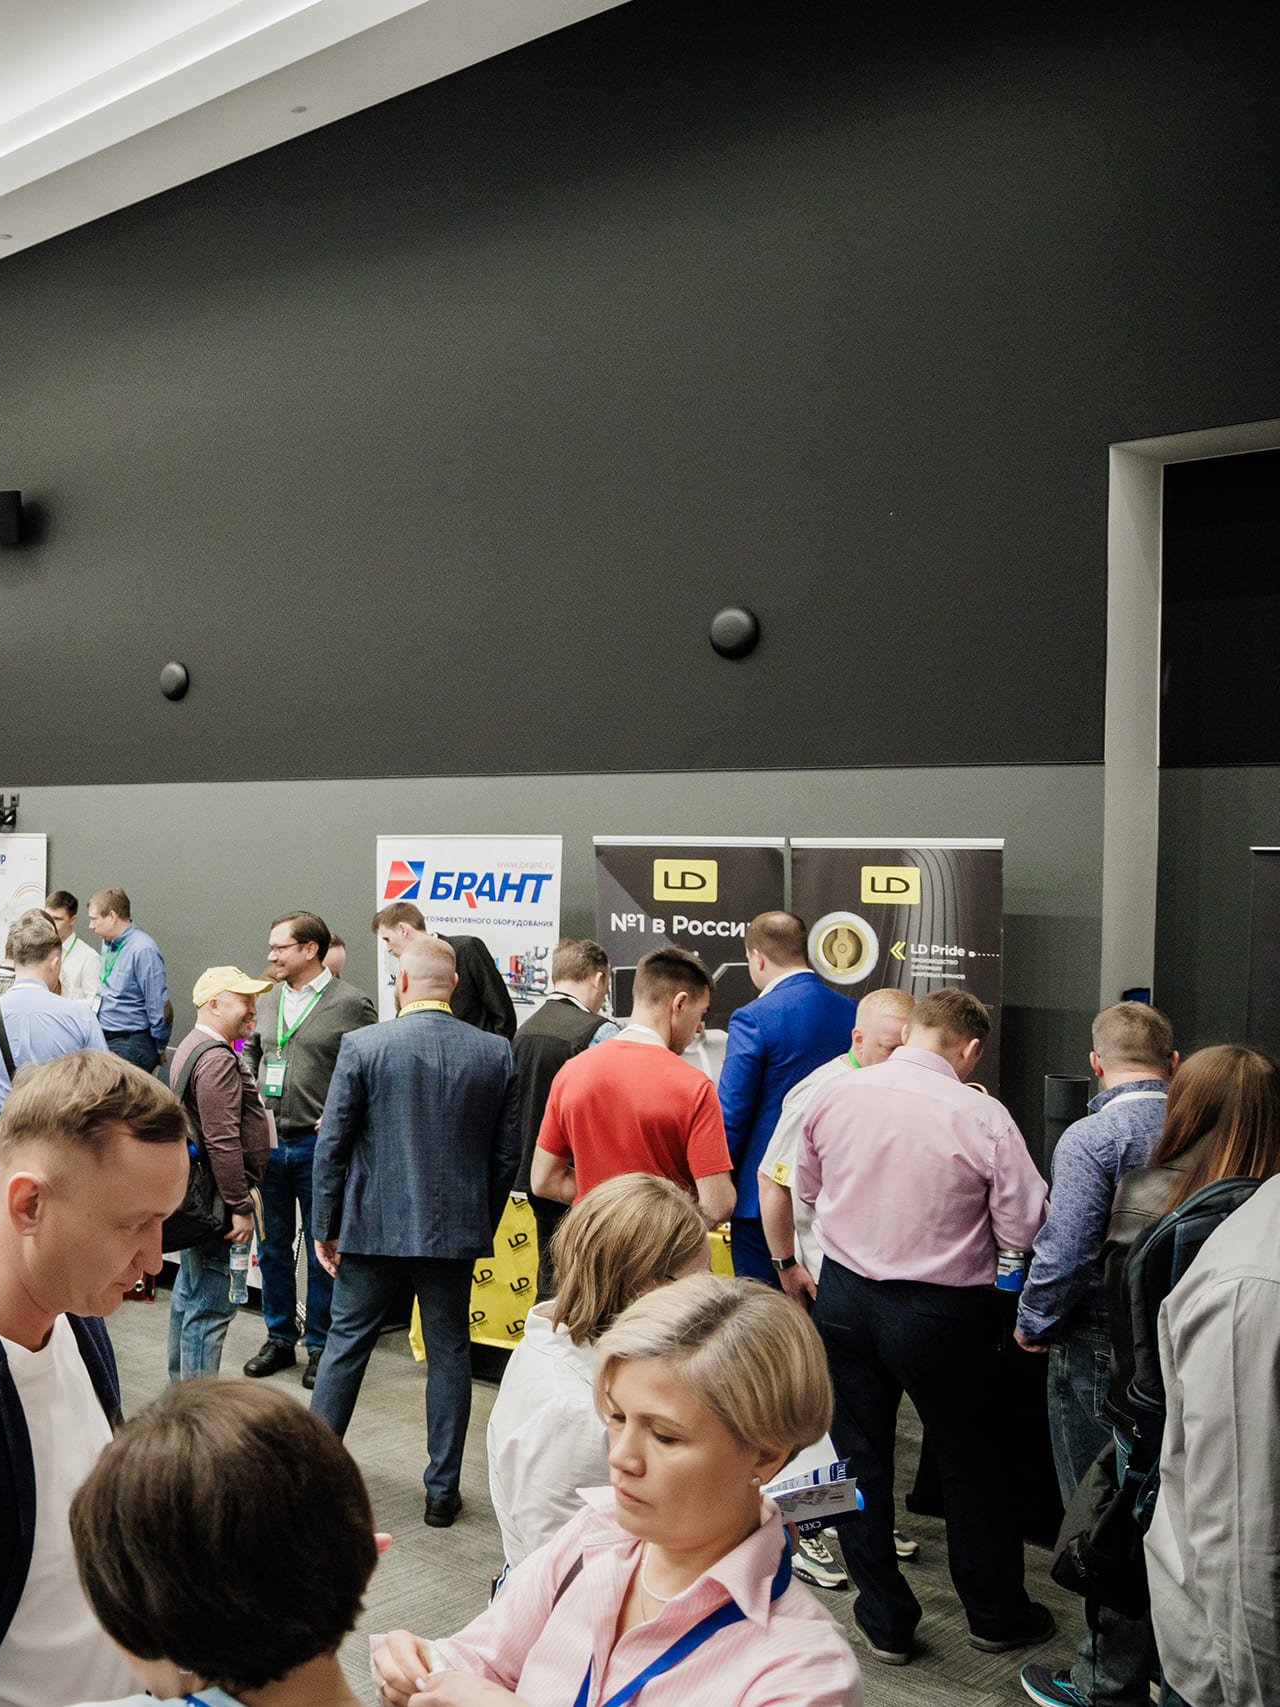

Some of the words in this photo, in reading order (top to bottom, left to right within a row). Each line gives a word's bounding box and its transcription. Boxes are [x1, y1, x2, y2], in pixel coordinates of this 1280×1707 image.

[664, 871, 707, 890] LD
[870, 876, 910, 893] LD
[429, 872, 554, 908] БРАНТ
[424, 916, 492, 925] ГОЭФФЕКТИВНОГО
[493, 919, 554, 928] ОБОРУДОВАНИЯ
[610, 913, 646, 933] №1
[652, 918, 666, 934] в
[672, 915, 751, 938] Росси
[910, 943, 928, 955] LD
[930, 944, 966, 957] Pride
[507, 1232, 528, 1249] LD
[472, 1269, 493, 1284] LD
[510, 1277, 530, 1293] LD
[469, 1311, 486, 1326] D
